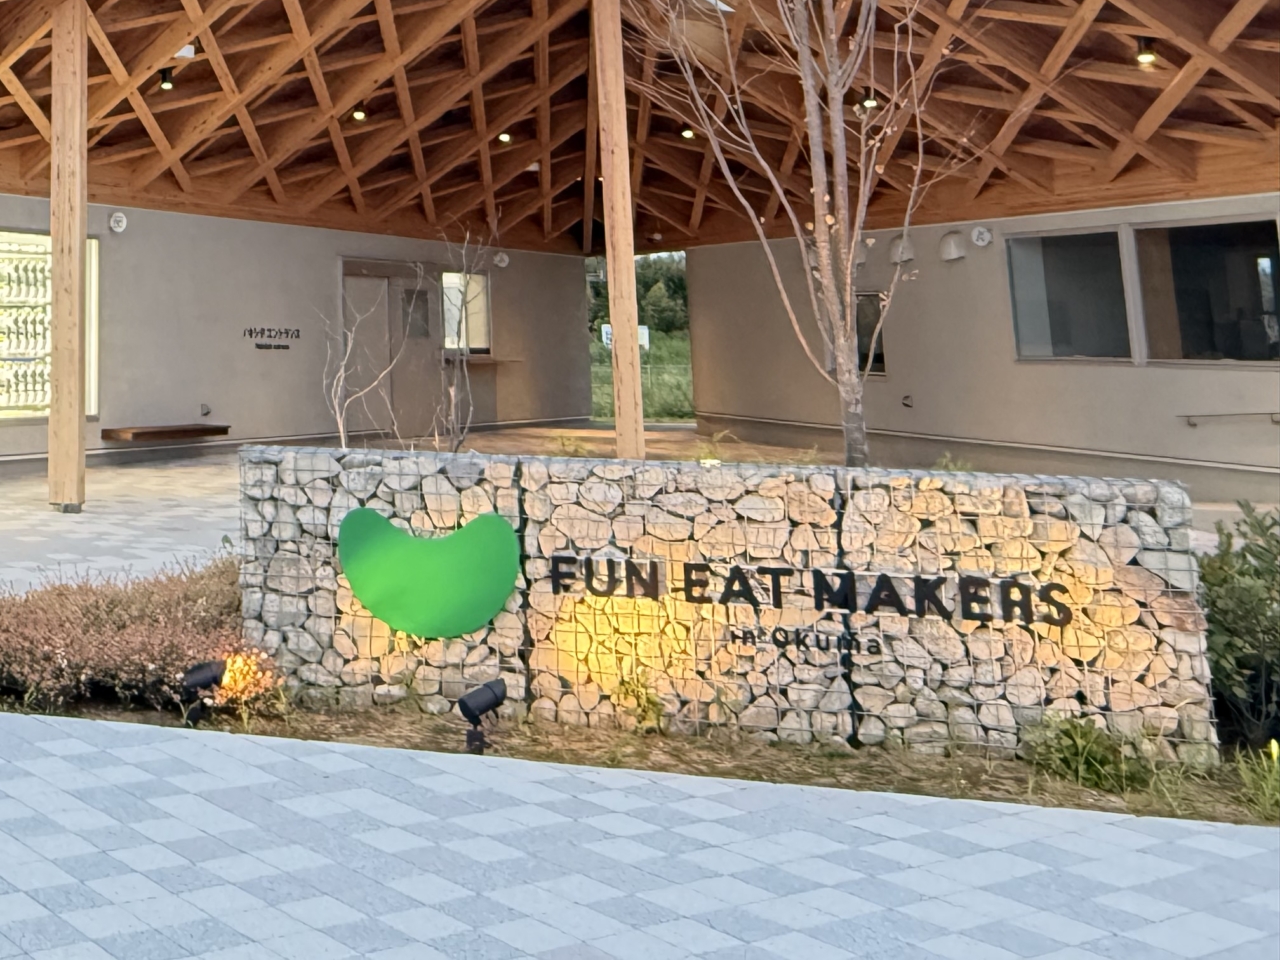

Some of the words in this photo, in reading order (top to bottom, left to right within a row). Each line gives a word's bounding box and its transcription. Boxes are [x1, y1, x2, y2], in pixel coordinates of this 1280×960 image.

[551, 556, 659, 601] FUN
[683, 562, 794, 609] EAT
[813, 568, 1073, 628] MAKERS
[731, 628, 756, 647] in
[772, 627, 881, 655] Okuma
